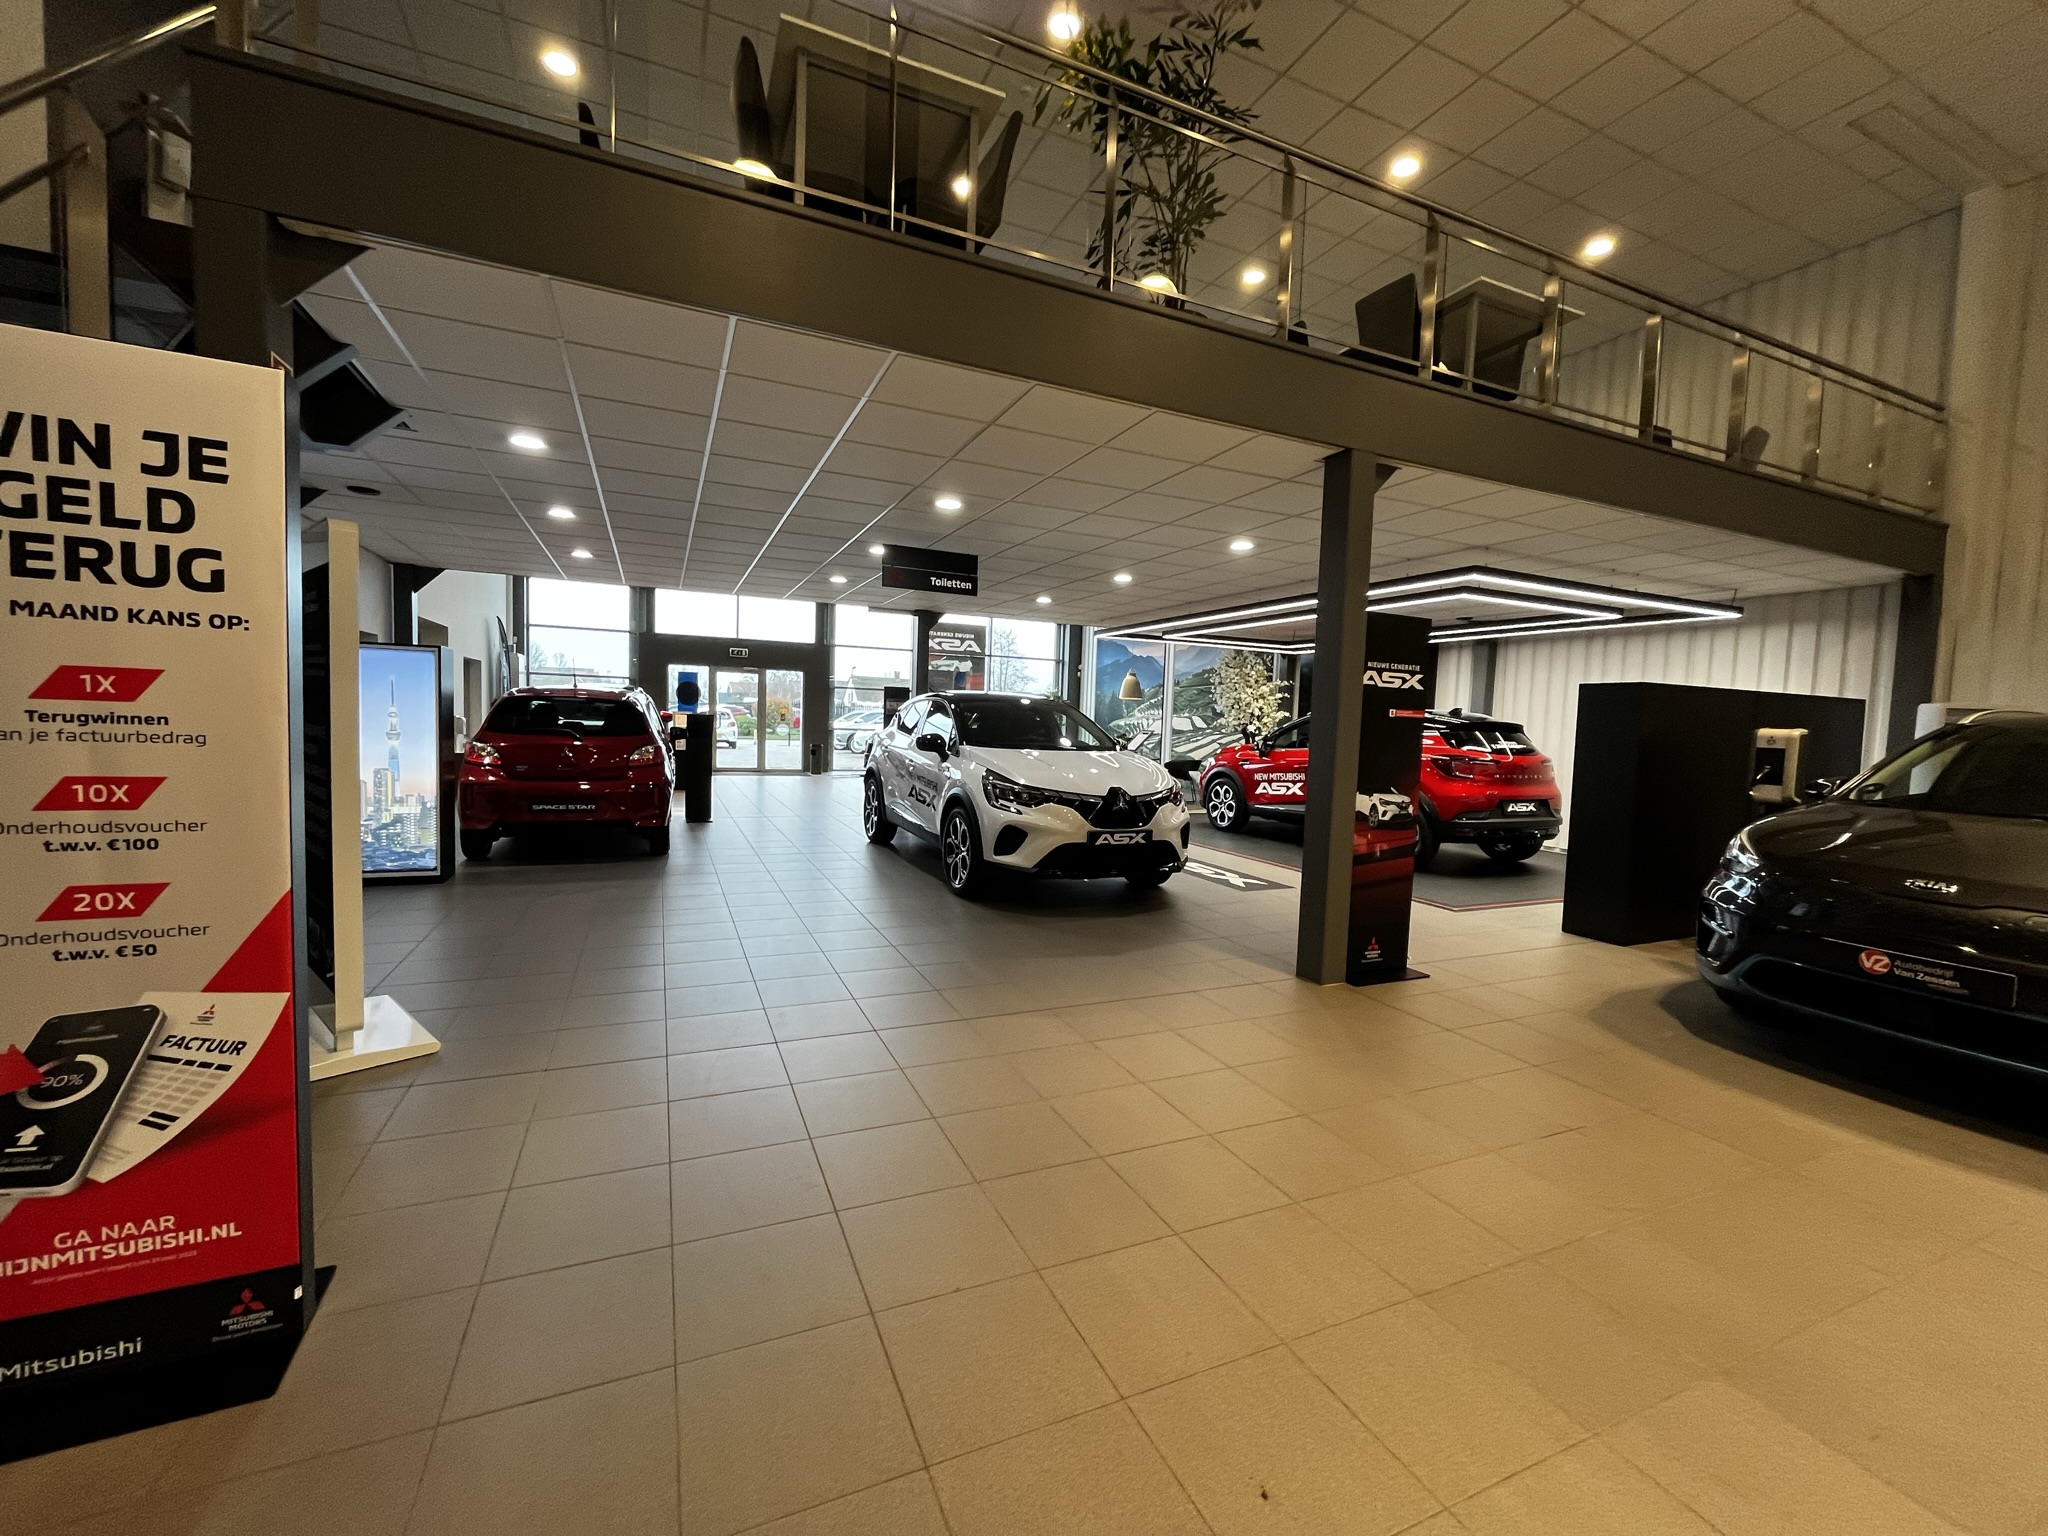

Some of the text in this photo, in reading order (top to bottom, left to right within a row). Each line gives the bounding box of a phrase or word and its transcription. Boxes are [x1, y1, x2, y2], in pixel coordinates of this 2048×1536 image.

[141, 430, 229, 484] JE
[0, 470, 195, 534] GELD
[0, 529, 225, 593] ERUG
[930, 577, 972, 590] Toiletten
[9, 600, 250, 631] MAAND KANS OP:
[1367, 661, 1421, 672] NIEUWE GENERATIE
[80, 674, 116, 693] 1X
[1363, 670, 1424, 690] ASX
[24, 710, 169, 727] Terugwinnen
[0, 728, 207, 747] an je factuurbedrag
[71, 784, 130, 803] 10X
[908, 784, 937, 812] ASX
[1254, 782, 1305, 796] ASX
[1507, 802, 1537, 812] ASX
[42, 838, 160, 852] t.w.v. €100
[1094, 832, 1146, 845] ASX
[73, 891, 136, 912] 20X
[52, 943, 158, 962] t.w.v. €50
[159, 1034, 248, 1056] FACTUUR
[53, 1215, 176, 1248] GA NAAR
[220, 1309, 274, 1326] MITSUBISHI
[228, 1318, 268, 1332] MOTORS
[0, 1337, 142, 1382] Mitsubishi
